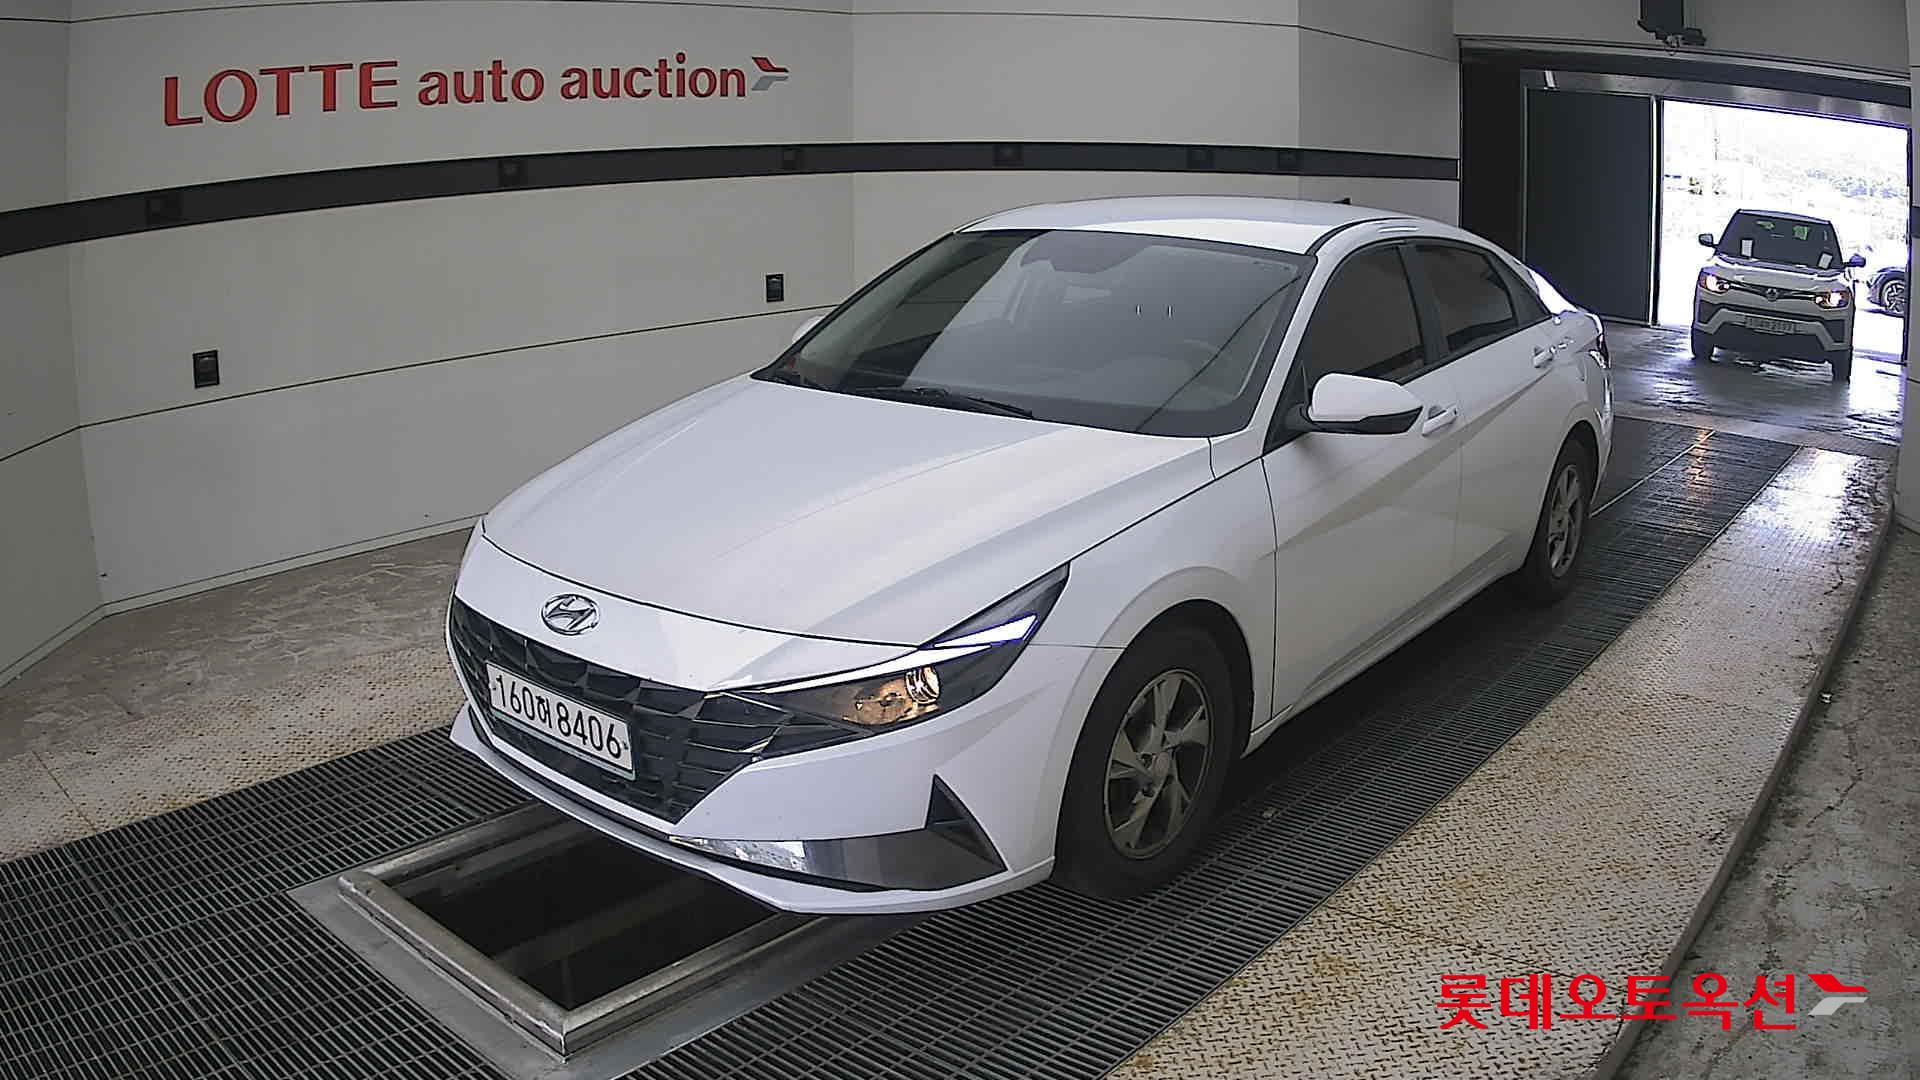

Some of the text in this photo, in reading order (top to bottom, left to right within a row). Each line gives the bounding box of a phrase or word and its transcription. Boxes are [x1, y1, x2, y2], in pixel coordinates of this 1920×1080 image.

[164, 52, 747, 126] LOTTE auto auction
